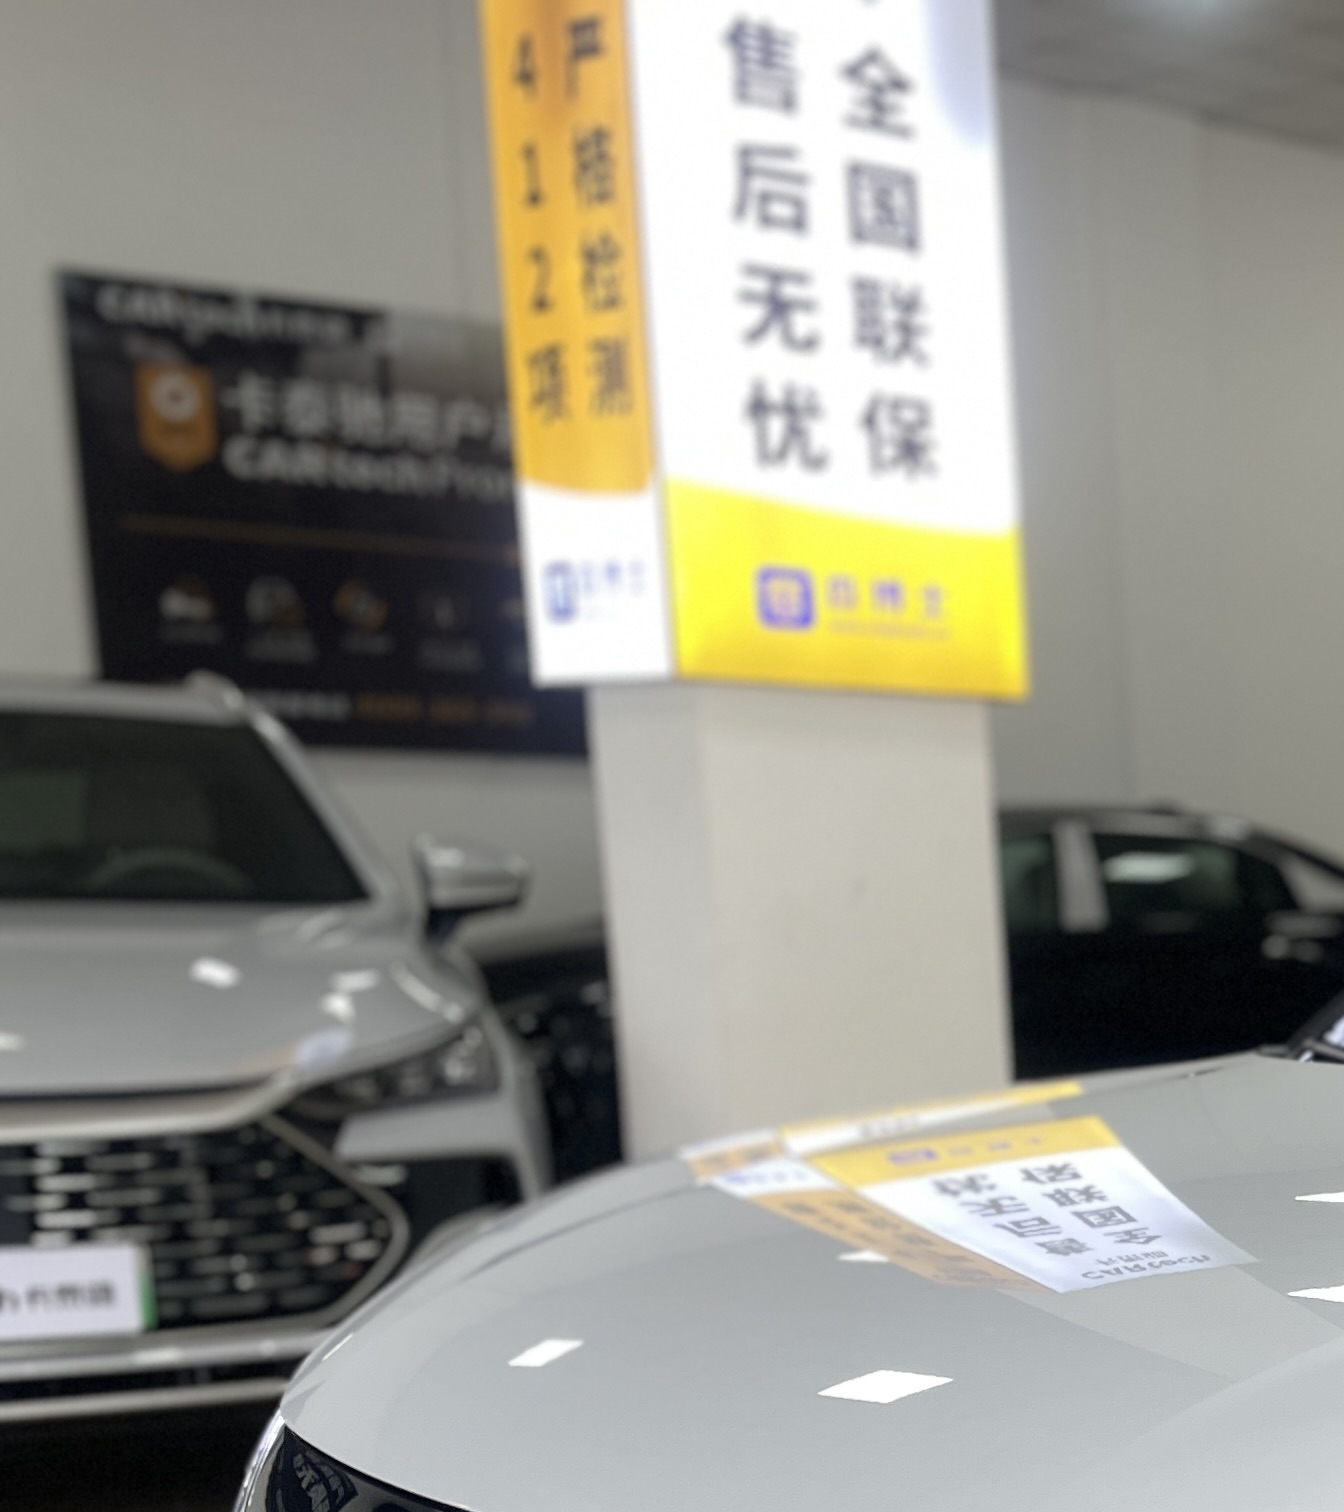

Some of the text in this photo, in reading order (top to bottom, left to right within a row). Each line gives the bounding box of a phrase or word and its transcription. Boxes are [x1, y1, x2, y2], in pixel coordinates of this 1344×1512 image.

[566, 16, 633, 417] 严格检测
[724, 15, 830, 472] 售后无忧
[839, 45, 938, 478] 全国联保
